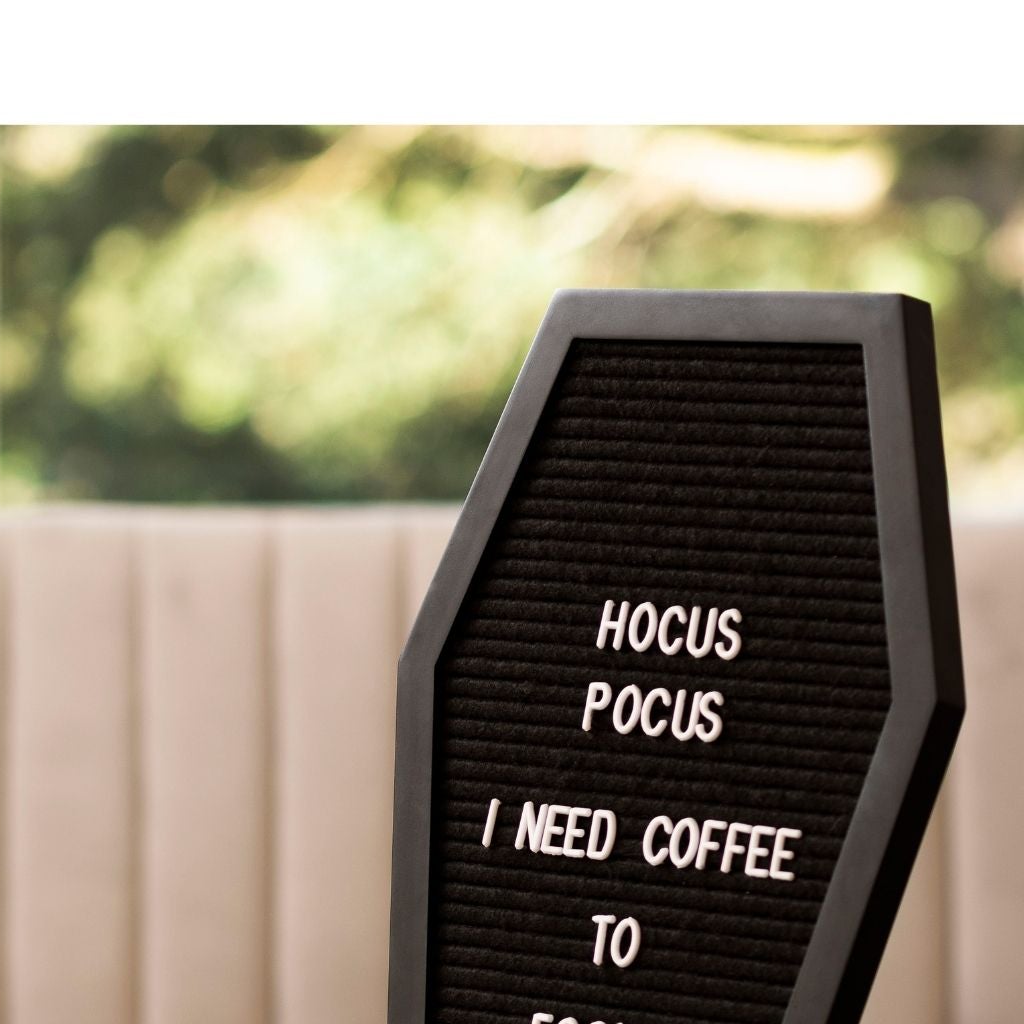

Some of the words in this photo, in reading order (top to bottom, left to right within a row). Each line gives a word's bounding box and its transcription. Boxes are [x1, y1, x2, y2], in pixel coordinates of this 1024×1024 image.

[595, 599, 742, 661] HOCUS
[581, 681, 724, 743] POCUS
[481, 797, 501, 848] I
[514, 800, 617, 861] NEED
[642, 815, 802, 881] COFFEE
[591, 914, 641, 968] TO
